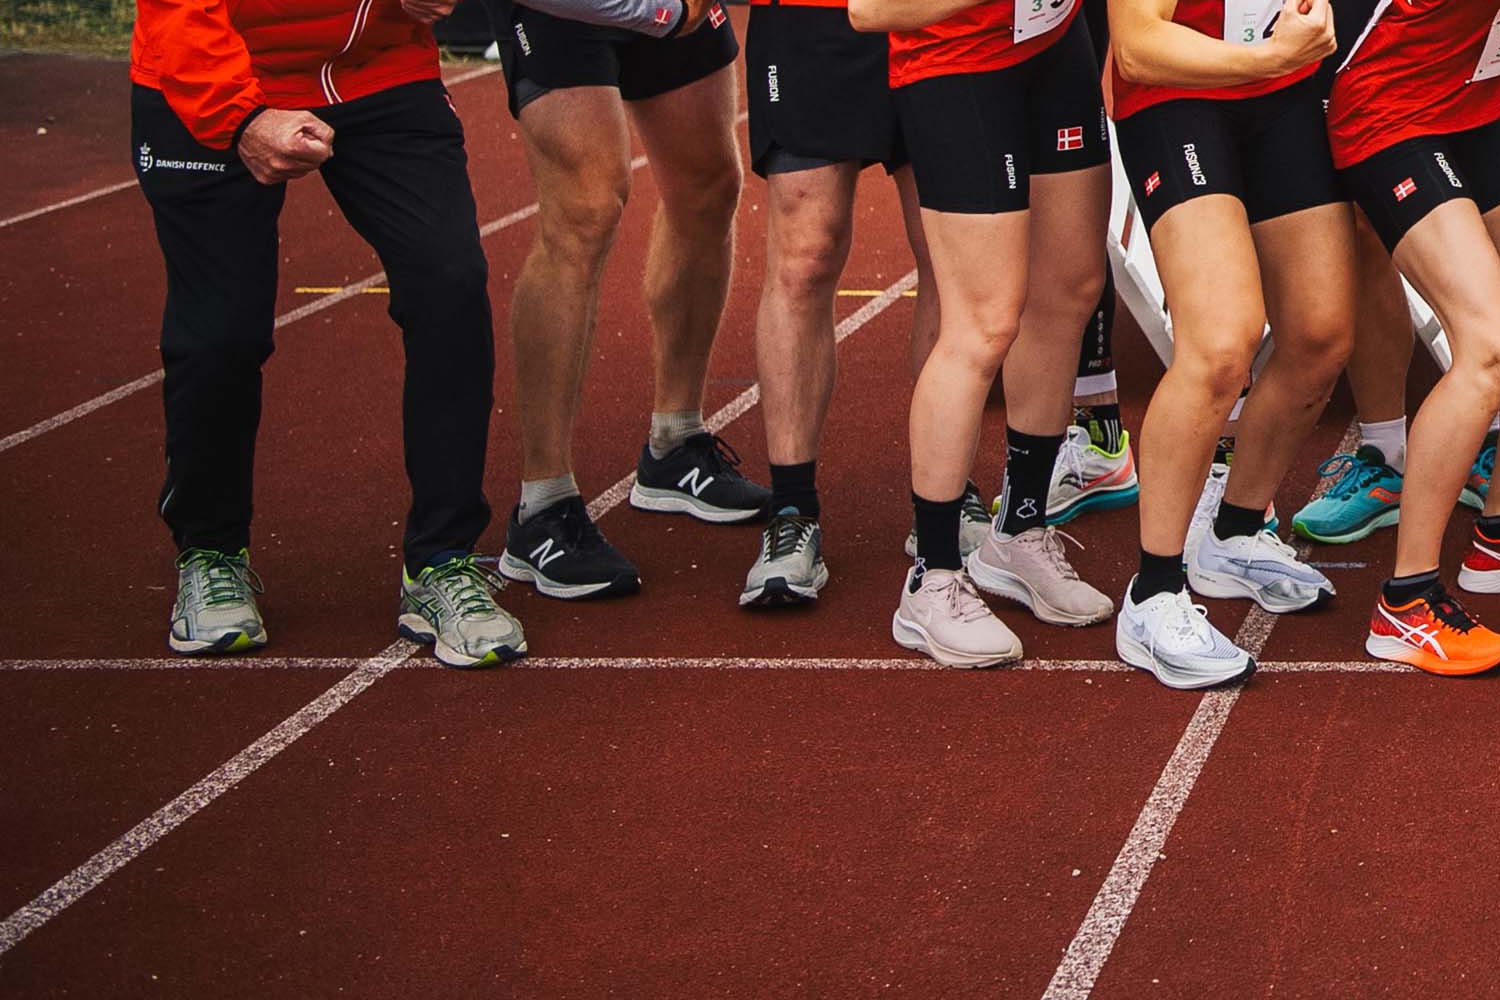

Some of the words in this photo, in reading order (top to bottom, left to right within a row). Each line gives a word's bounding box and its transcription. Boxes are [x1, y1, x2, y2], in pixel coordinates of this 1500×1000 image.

[514, 23, 532, 56] FUSION
[1243, 28, 1255, 42] 3
[768, 65, 780, 102] FUSION
[156, 160, 185, 169] DANISH
[186, 161, 226, 172] DEFENCE
[1004, 153, 1017, 189] FUSION
[677, 467, 715, 497] N
[529, 538, 566, 570] N
